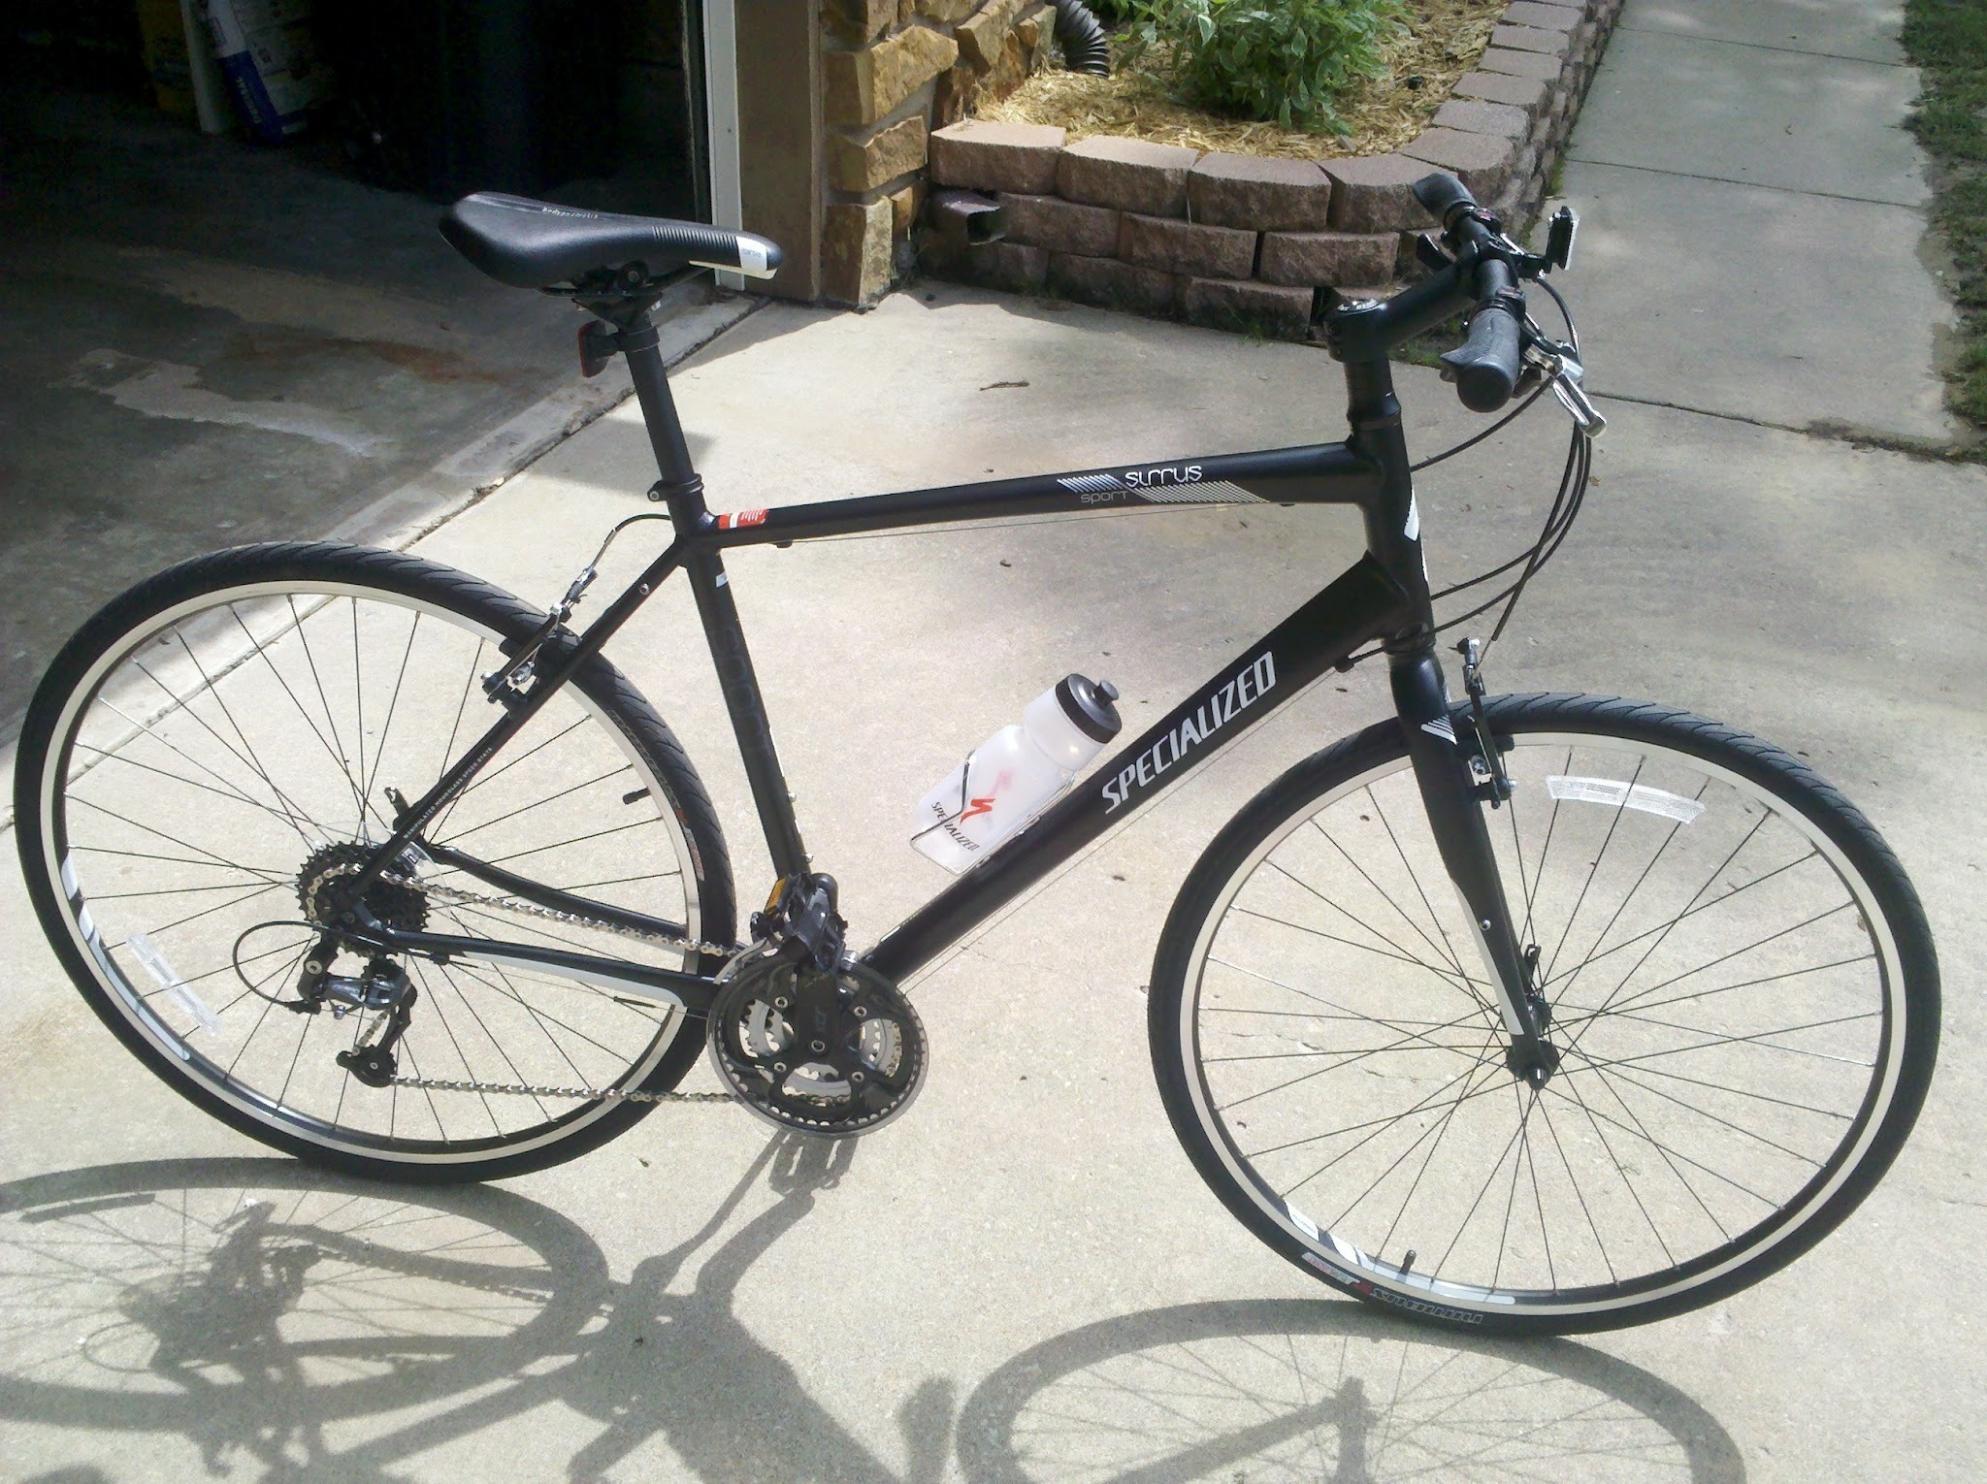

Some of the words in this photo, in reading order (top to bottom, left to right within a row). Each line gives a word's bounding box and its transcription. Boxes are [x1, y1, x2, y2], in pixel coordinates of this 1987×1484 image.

[1125, 465, 1202, 488] sirrus
[1079, 490, 1128, 504] sport
[1102, 651, 1276, 814] SPECIALIZED
